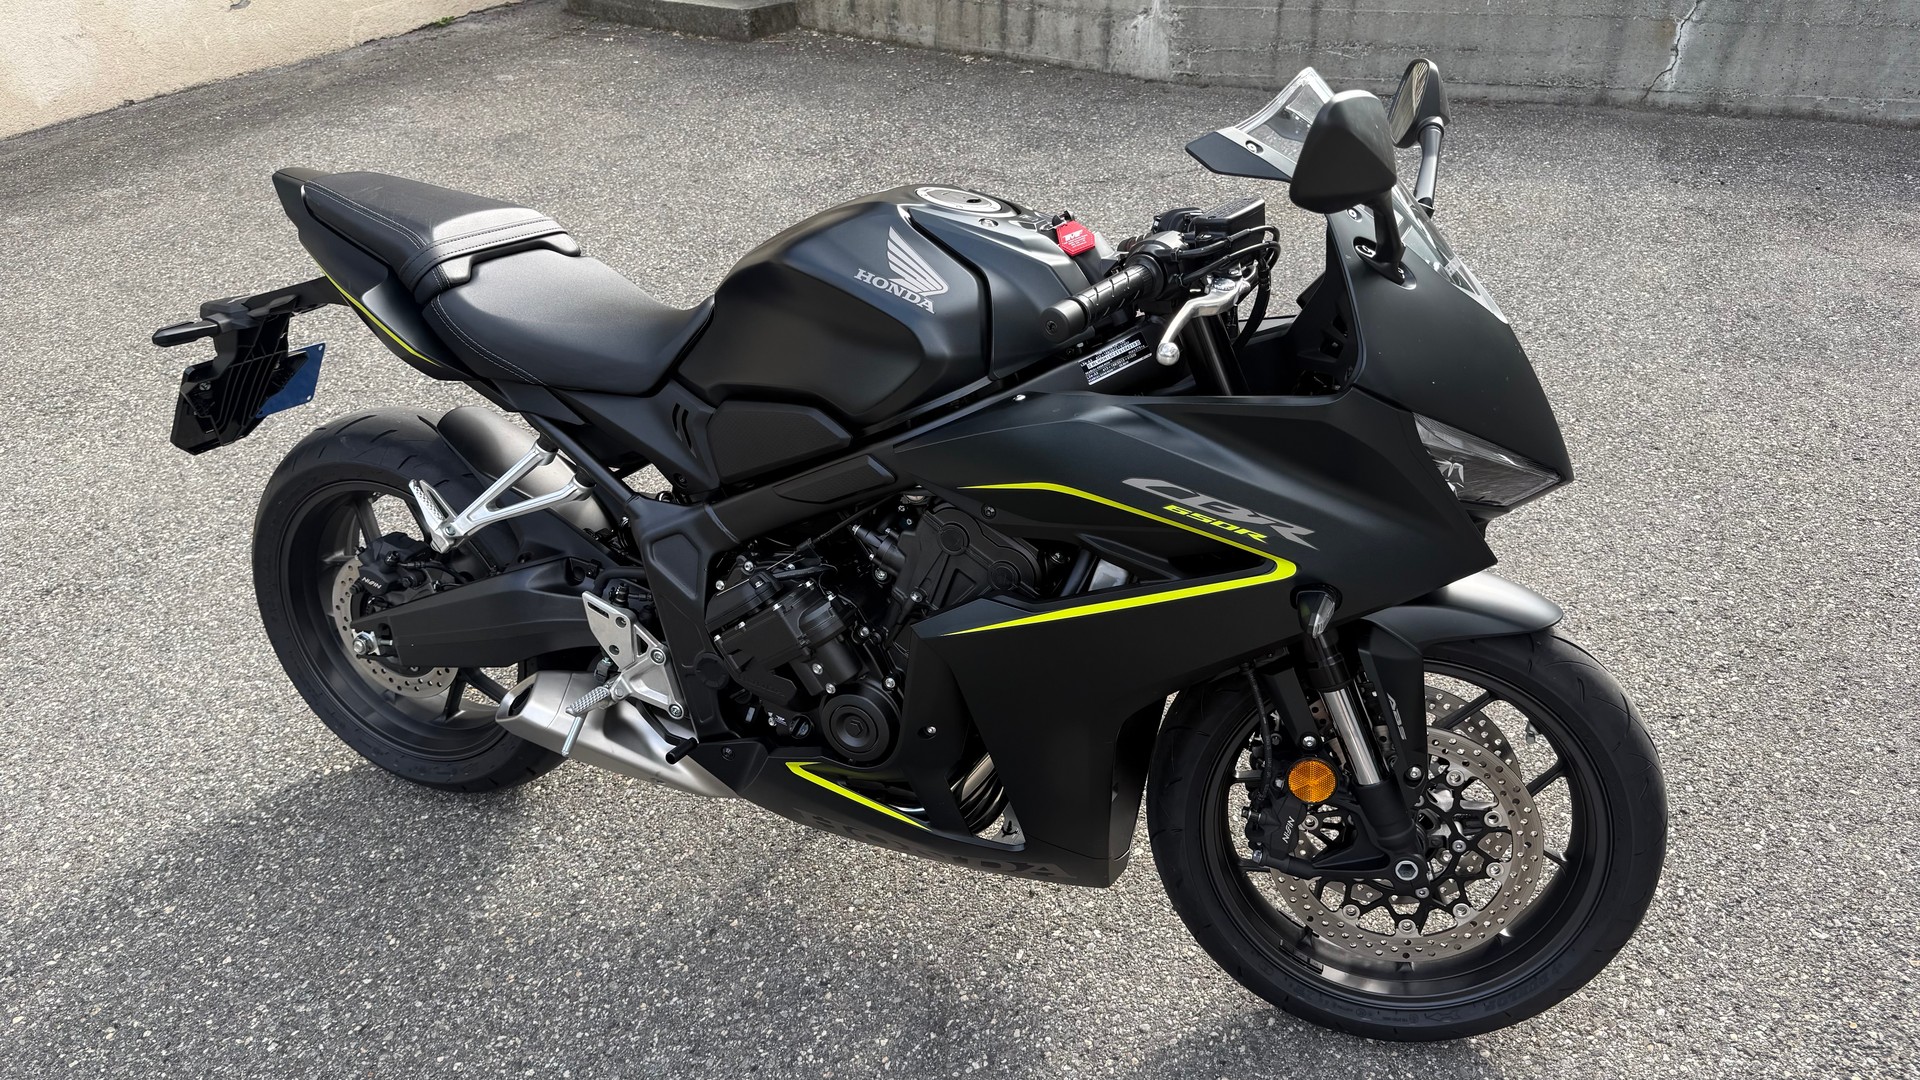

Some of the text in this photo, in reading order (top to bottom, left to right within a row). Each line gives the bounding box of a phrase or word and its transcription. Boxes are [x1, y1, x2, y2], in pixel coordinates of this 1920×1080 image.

[853, 268, 935, 314] HONDA
[1122, 478, 1320, 551] CBR
[1163, 504, 1268, 544] 650R
